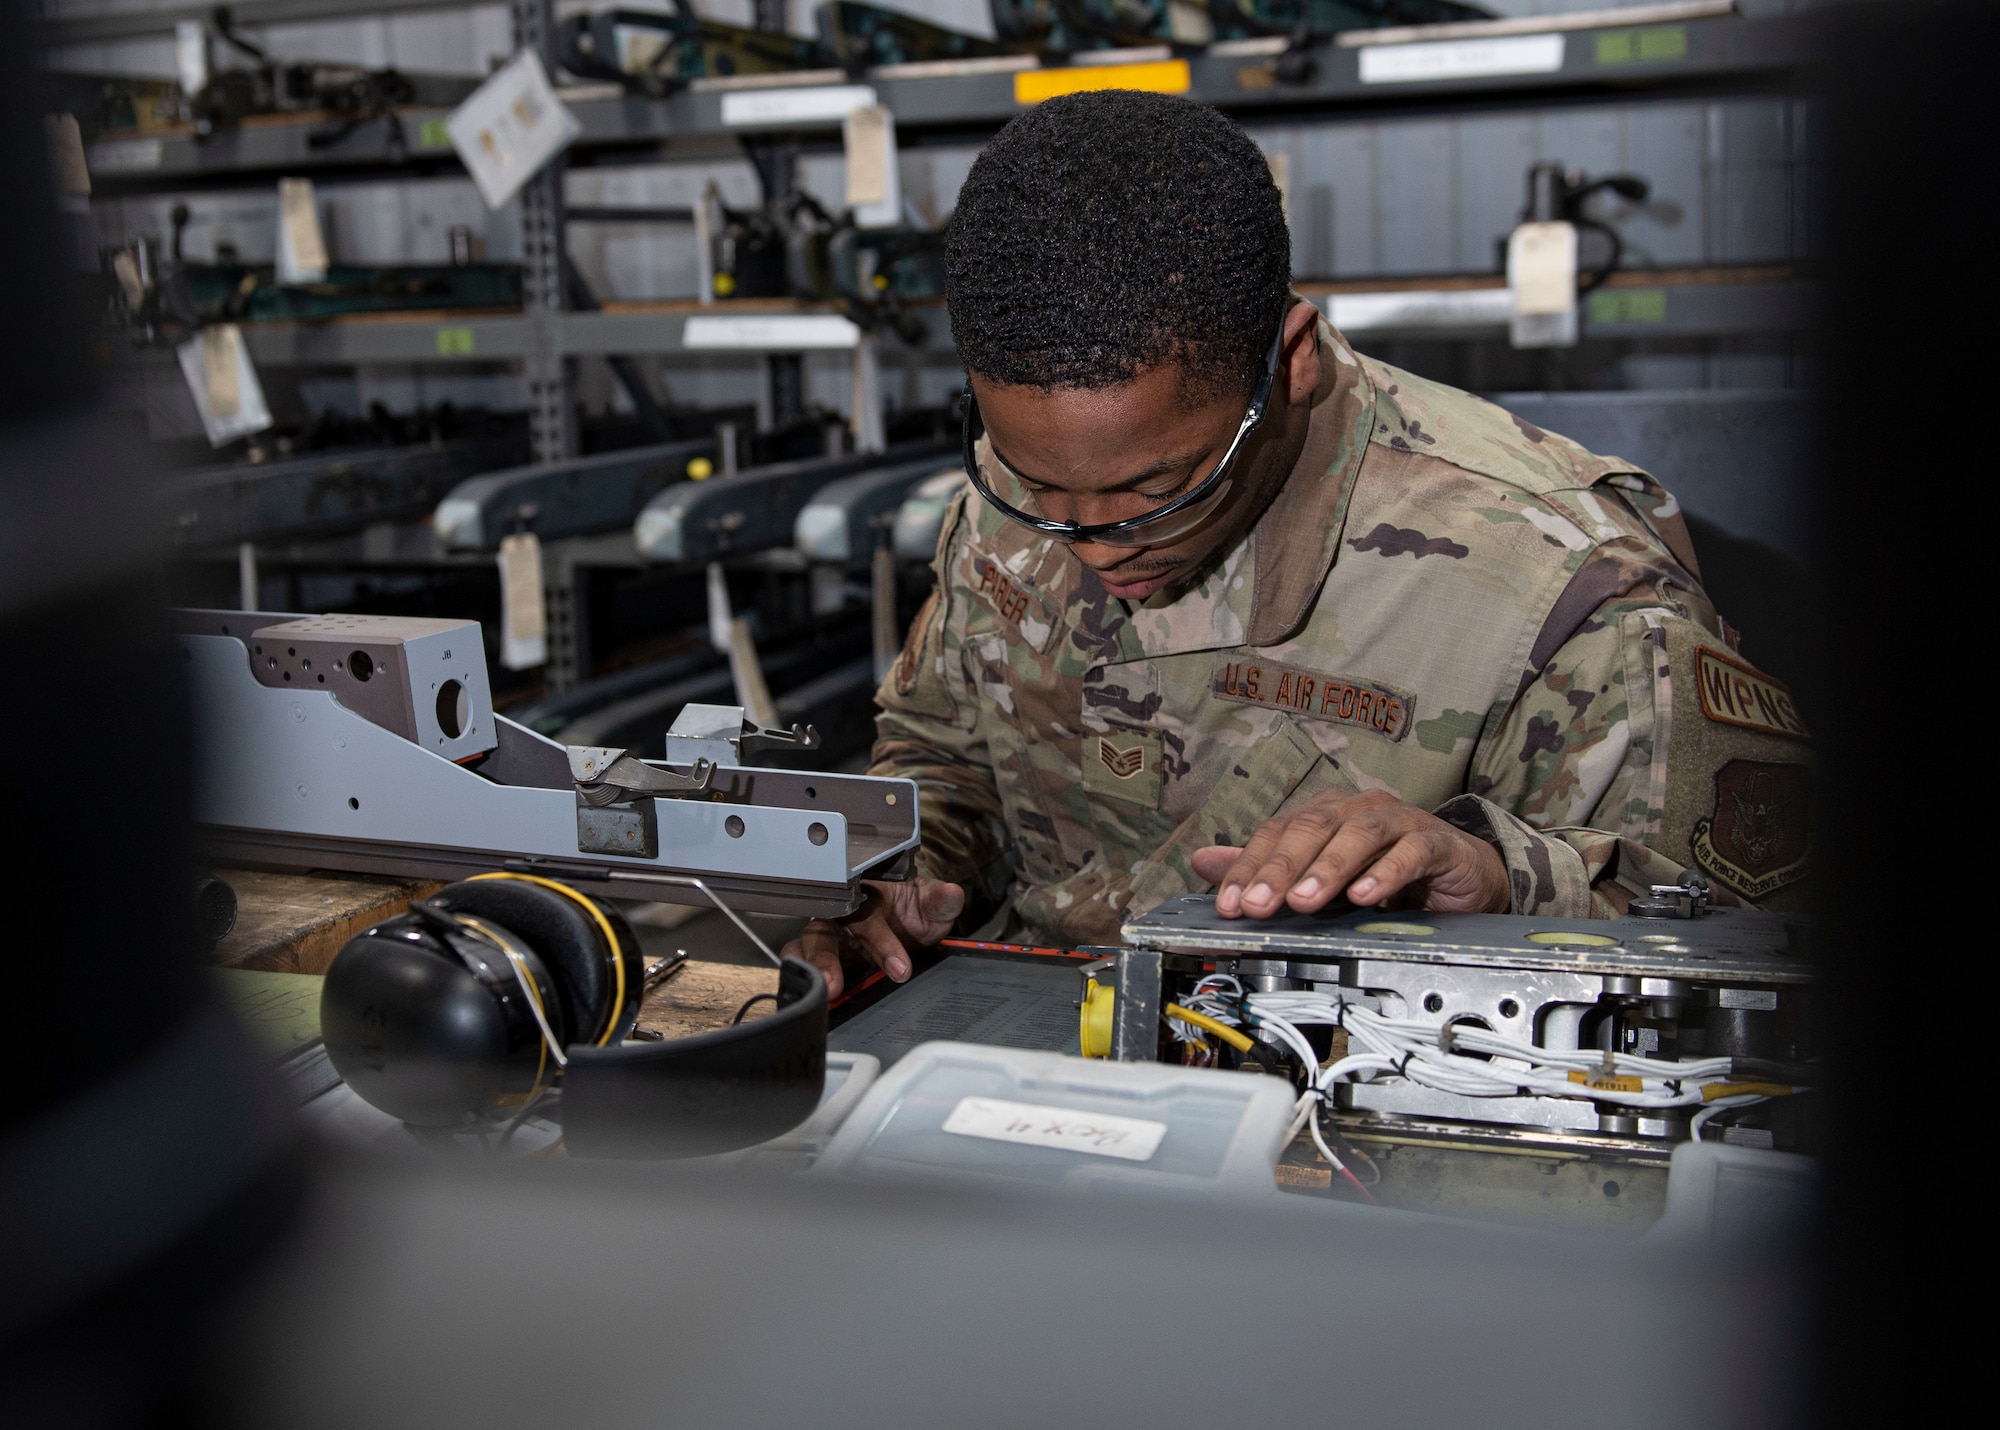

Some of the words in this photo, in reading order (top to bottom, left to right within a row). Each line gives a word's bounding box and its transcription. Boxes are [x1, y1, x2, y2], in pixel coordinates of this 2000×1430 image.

[979, 561, 1029, 626] PIPER
[1224, 662, 1265, 701] U.S.
[1275, 672, 1315, 711] AIR
[1320, 681, 1401, 734] FORCE
[1703, 661, 1803, 735] WPNS
[1696, 843, 1711, 863] AIR
[1708, 856, 1739, 882] FORCE
[1737, 874, 1778, 894] RESERVE
